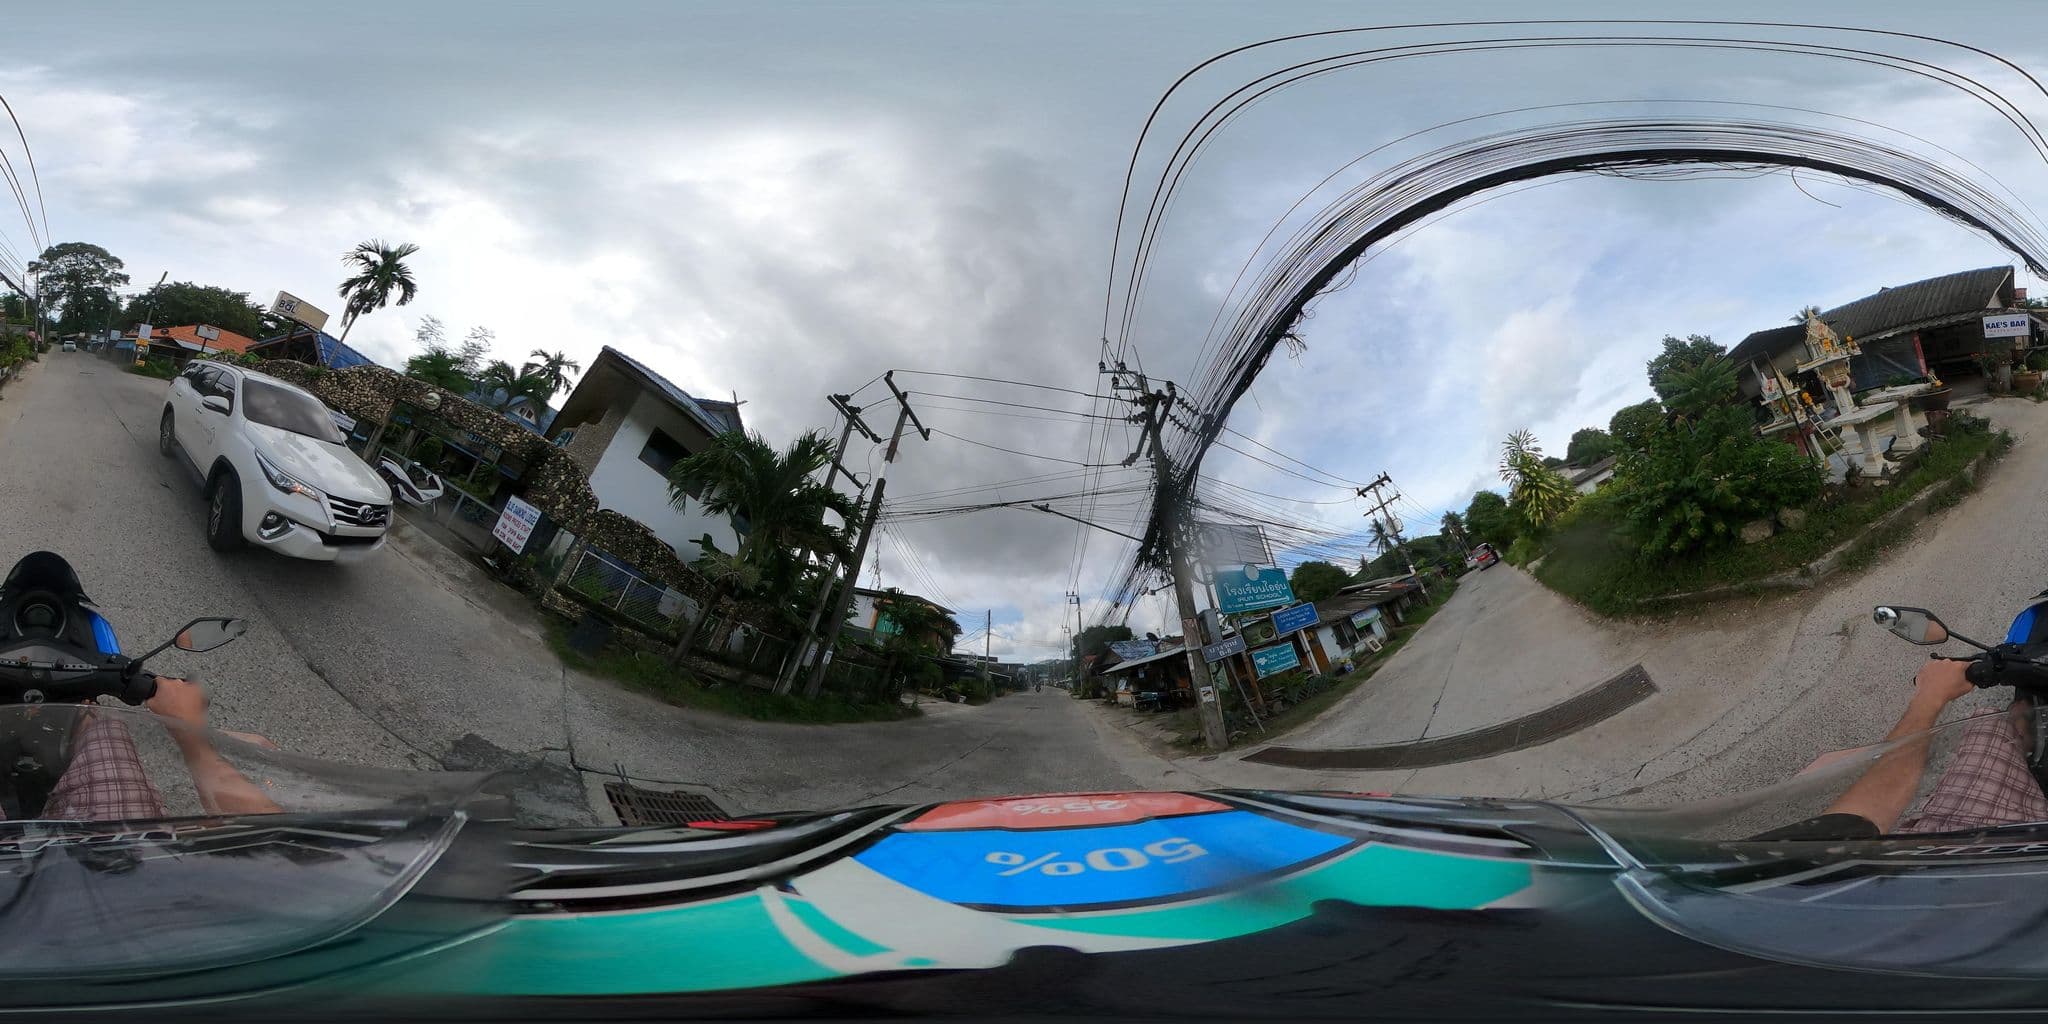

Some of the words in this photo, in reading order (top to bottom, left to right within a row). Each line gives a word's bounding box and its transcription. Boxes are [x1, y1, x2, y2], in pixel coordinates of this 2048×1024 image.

[1985, 321, 2008, 330] KAE'S
[2010, 320, 2026, 328] BAR
[985, 837, 1208, 877] 50%
